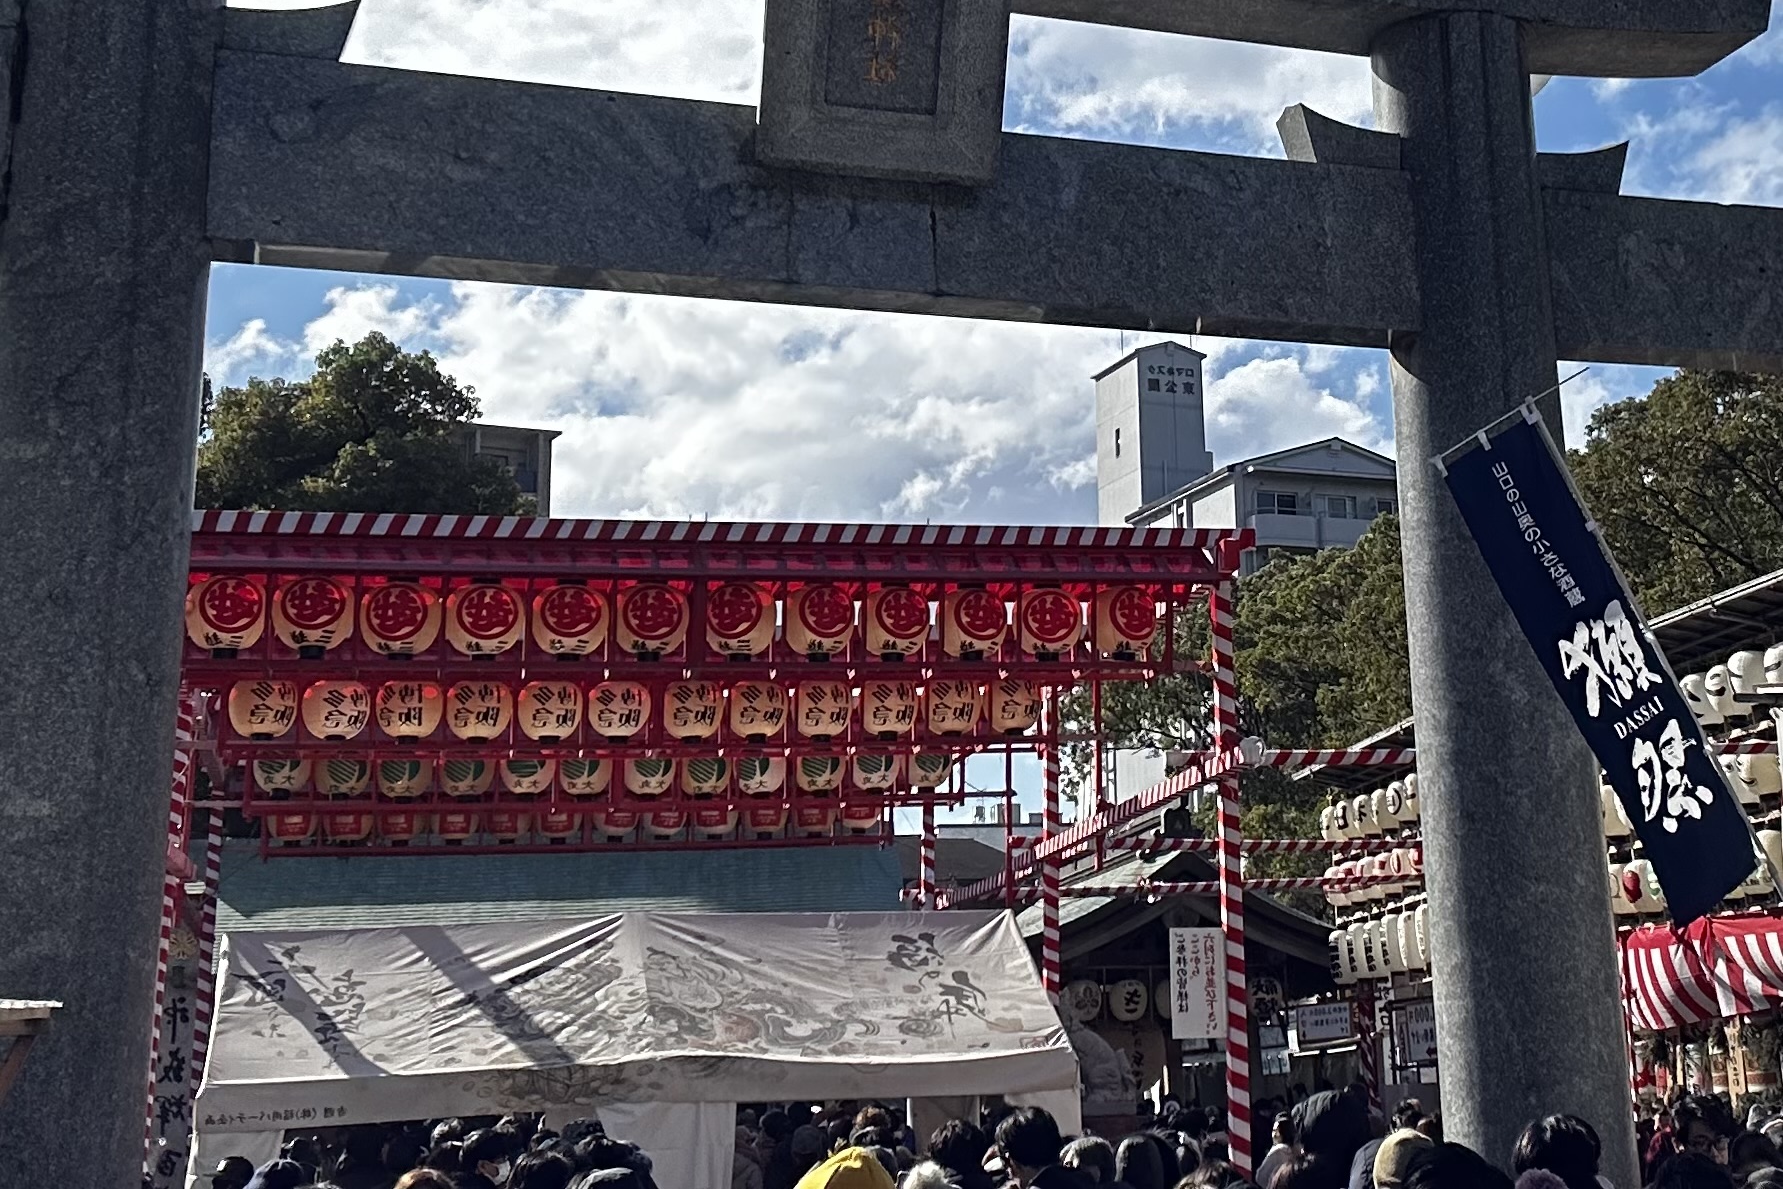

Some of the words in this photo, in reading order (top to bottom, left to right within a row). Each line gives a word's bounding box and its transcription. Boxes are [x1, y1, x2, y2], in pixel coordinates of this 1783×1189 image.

[1491, 461, 1586, 608] 山口の山奥の小さな酒蔵
[1558, 599, 1662, 717] 獺
[1613, 696, 1664, 739] DASSAI
[1632, 719, 1713, 833] 祭
